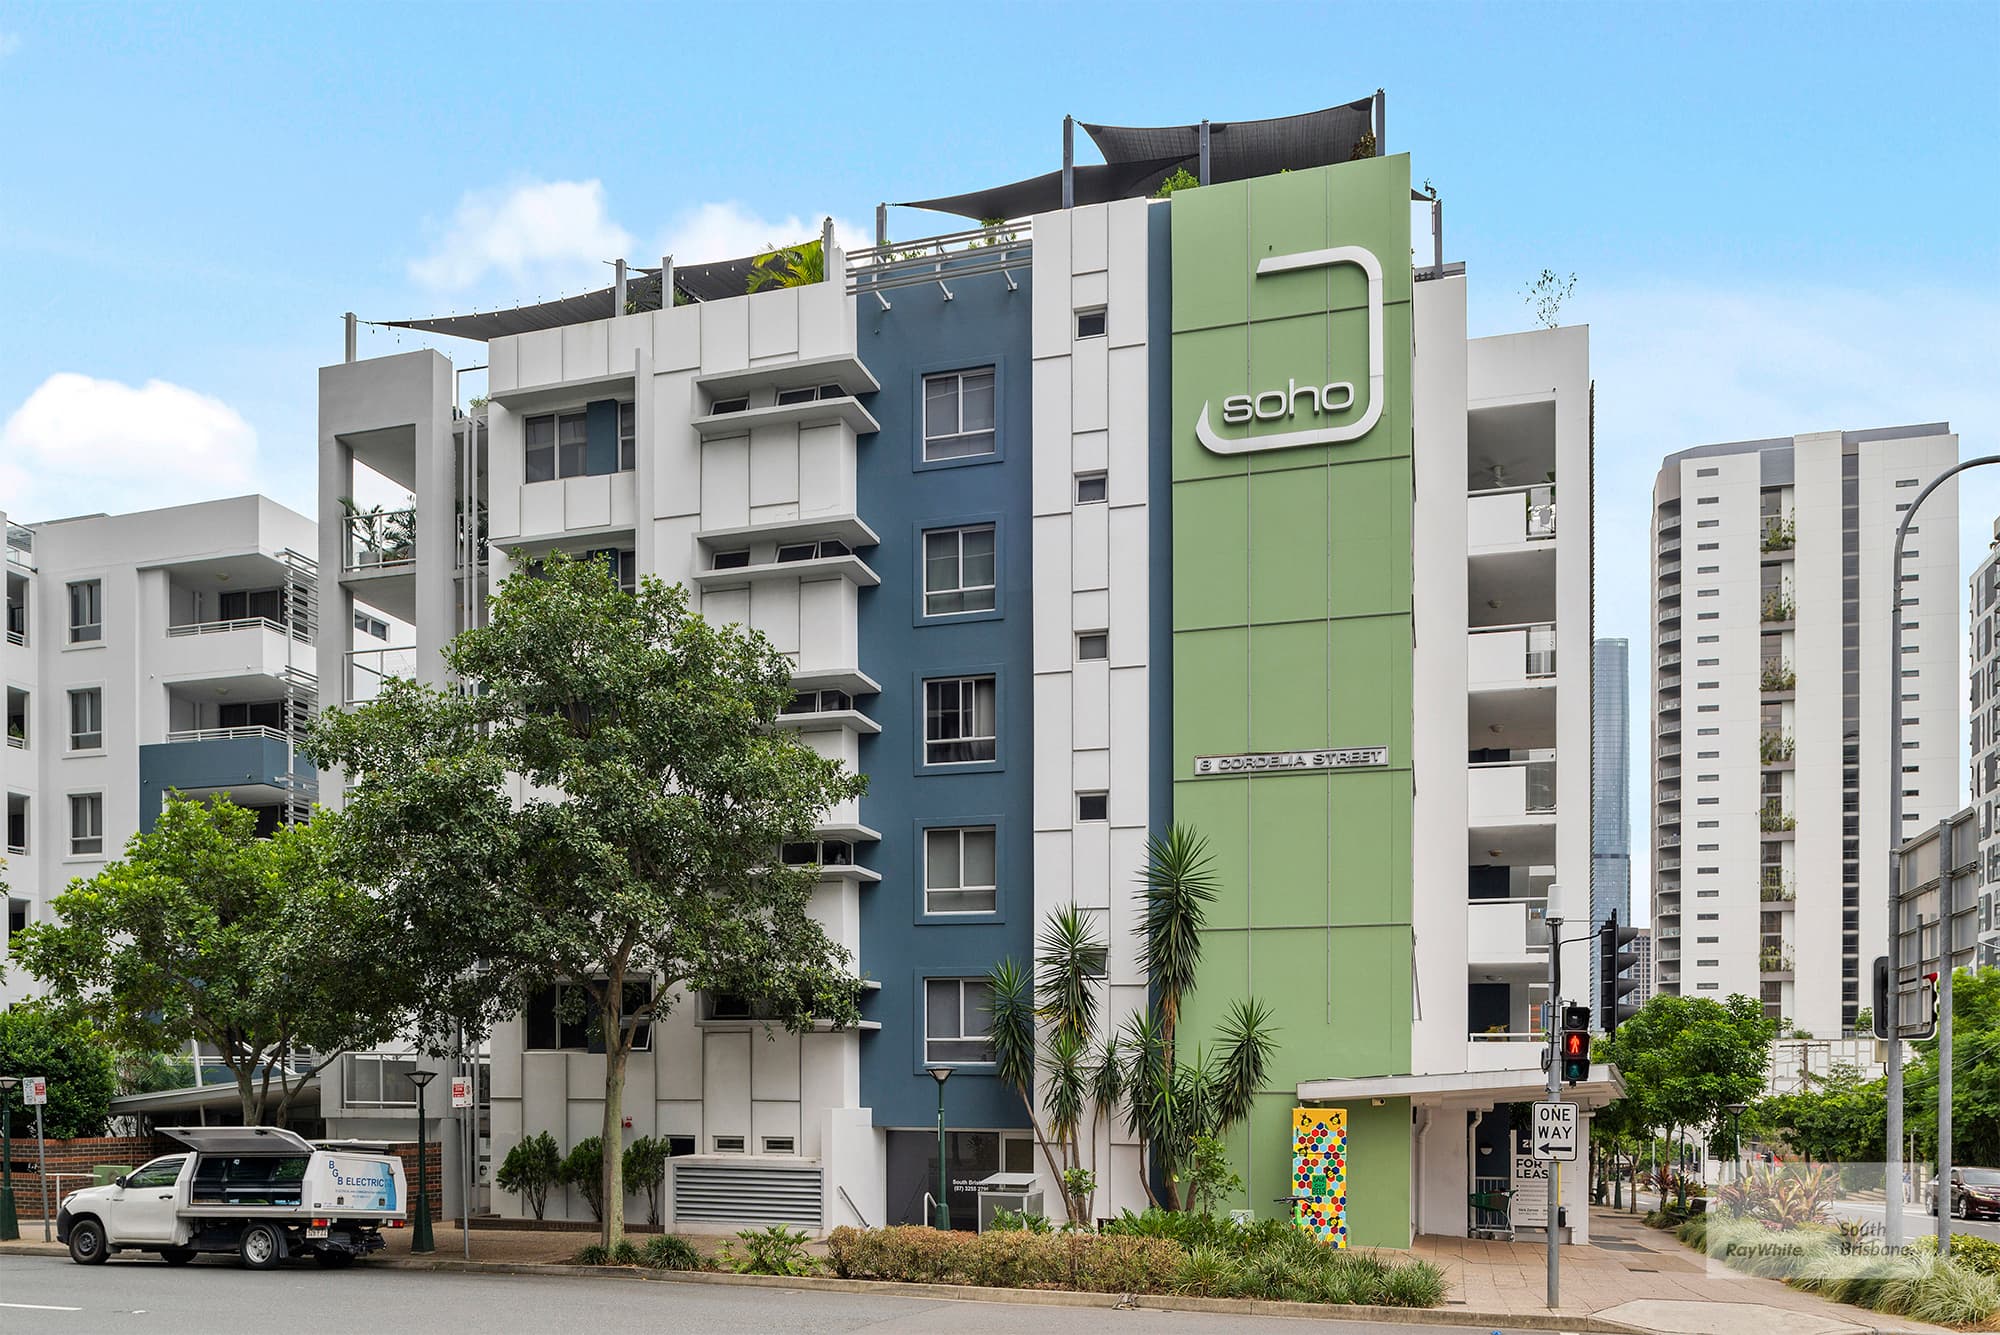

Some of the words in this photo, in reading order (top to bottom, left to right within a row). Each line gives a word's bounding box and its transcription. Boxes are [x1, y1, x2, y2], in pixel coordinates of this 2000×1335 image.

[1223, 378, 1355, 423] soho
[1218, 755, 1307, 770] CORDELIA
[1313, 751, 1382, 766] STREET
[1540, 1108, 1571, 1121] ONE
[1538, 1126, 1572, 1139] WAY
[1516, 1159, 1542, 1168] FOR
[346, 1177, 385, 1187] ELECTRIC
